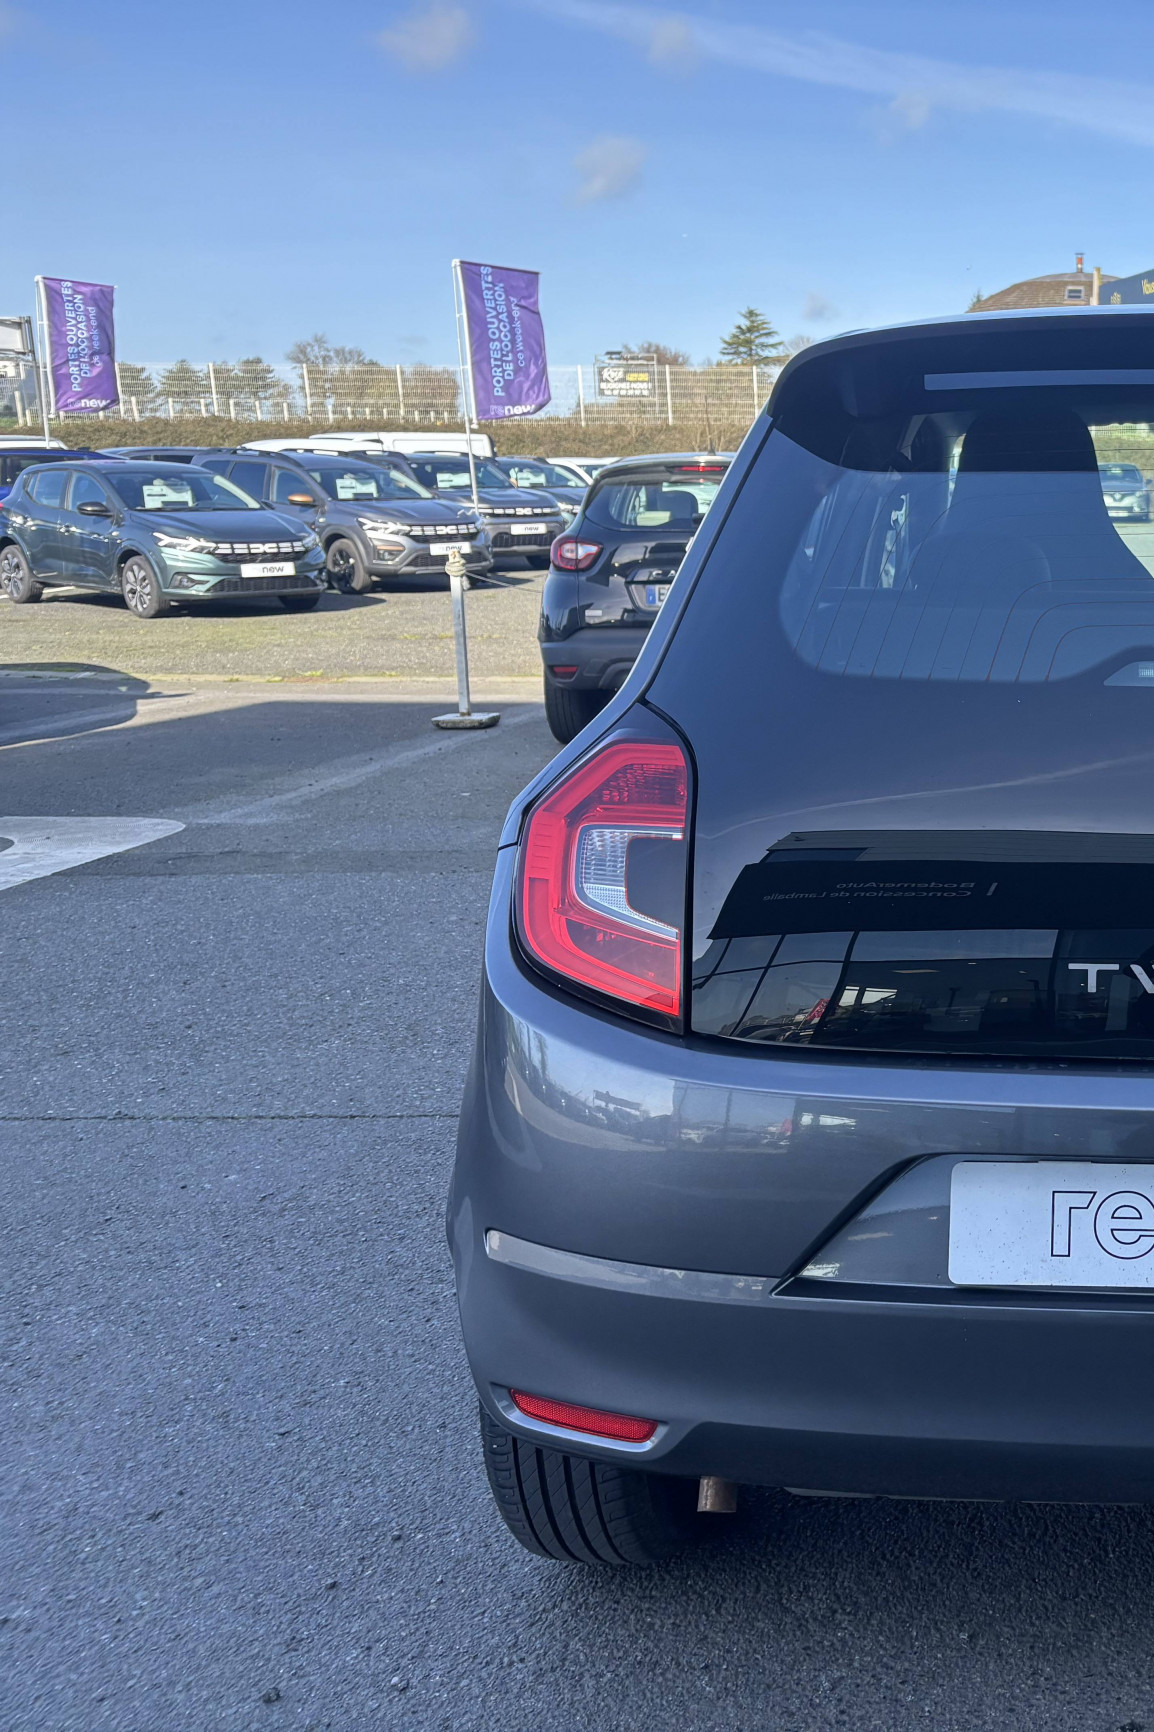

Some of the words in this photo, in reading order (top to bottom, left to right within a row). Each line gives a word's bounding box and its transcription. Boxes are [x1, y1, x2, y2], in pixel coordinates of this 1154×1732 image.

[61, 281, 77, 345] OUVERTES
[480, 265, 500, 339] OUVERTES
[494, 282, 513, 361] L'OCCASION
[67, 346, 82, 391] PORTES
[80, 363, 91, 377] DE
[489, 341, 506, 396] PORTES
[502, 362, 514, 379] DE
